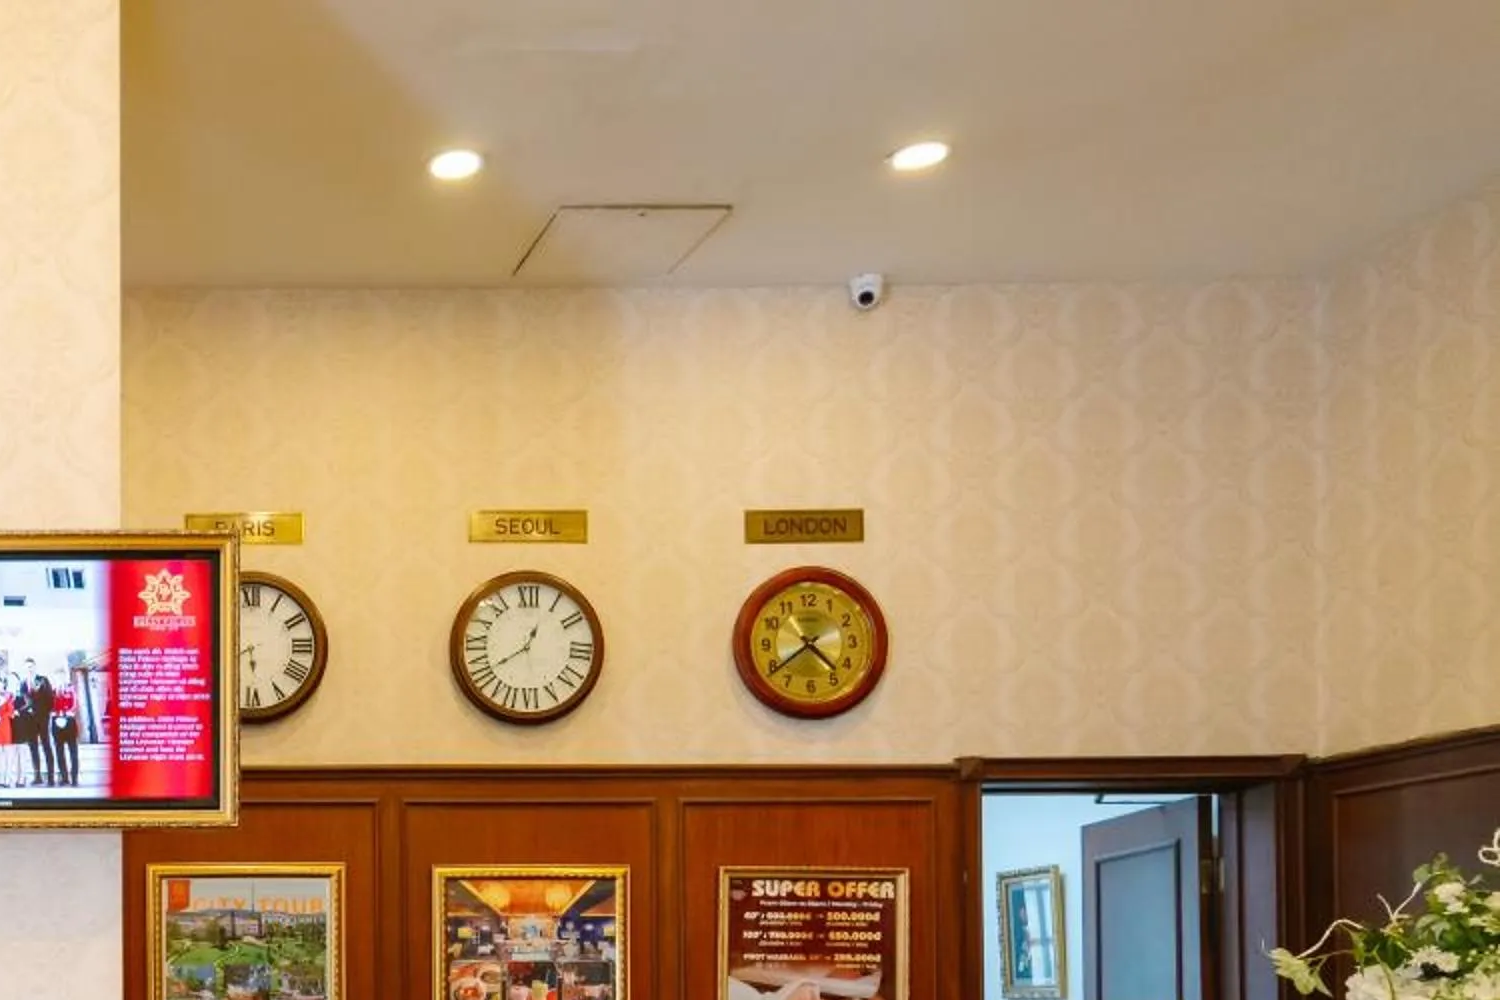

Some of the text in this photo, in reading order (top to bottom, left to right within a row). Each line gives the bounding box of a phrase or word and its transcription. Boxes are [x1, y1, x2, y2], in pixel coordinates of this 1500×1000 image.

[494, 518, 561, 535] SEOUL
[763, 517, 848, 536] LONDON
[800, 593, 817, 607] 12
[751, 879, 895, 899] SUPER OFFER
